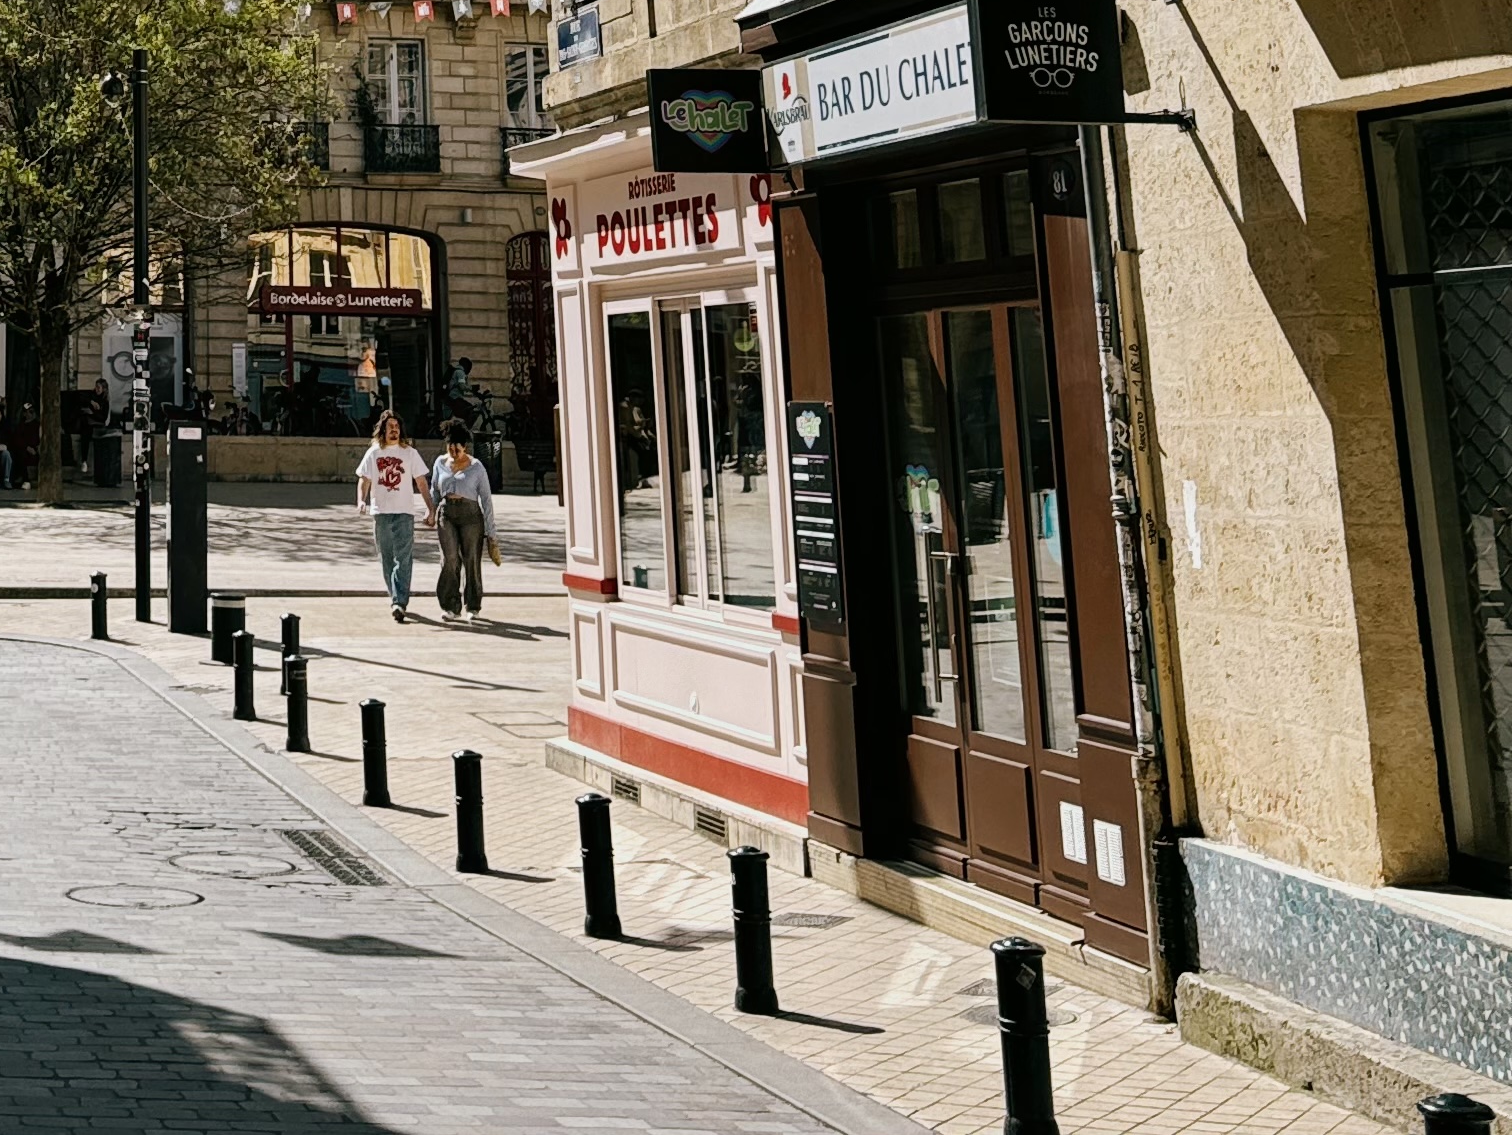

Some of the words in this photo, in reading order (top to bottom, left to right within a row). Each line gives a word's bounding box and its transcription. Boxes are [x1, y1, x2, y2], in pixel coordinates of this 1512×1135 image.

[1037, 6, 1057, 18] LES
[1007, 20, 1089, 45] GARÇONS
[1004, 44, 1099, 72] LUNETIERS
[817, 76, 855, 122] BAR
[859, 64, 891, 111] DU
[898, 41, 972, 101] CHALE
[628, 174, 676, 200] RÔTISSERIE
[1052, 169, 1068, 194] 81
[596, 192, 720, 259] POULETTES
[270, 291, 335, 306] Bordelaise
[348, 293, 414, 308] Lunetterie
